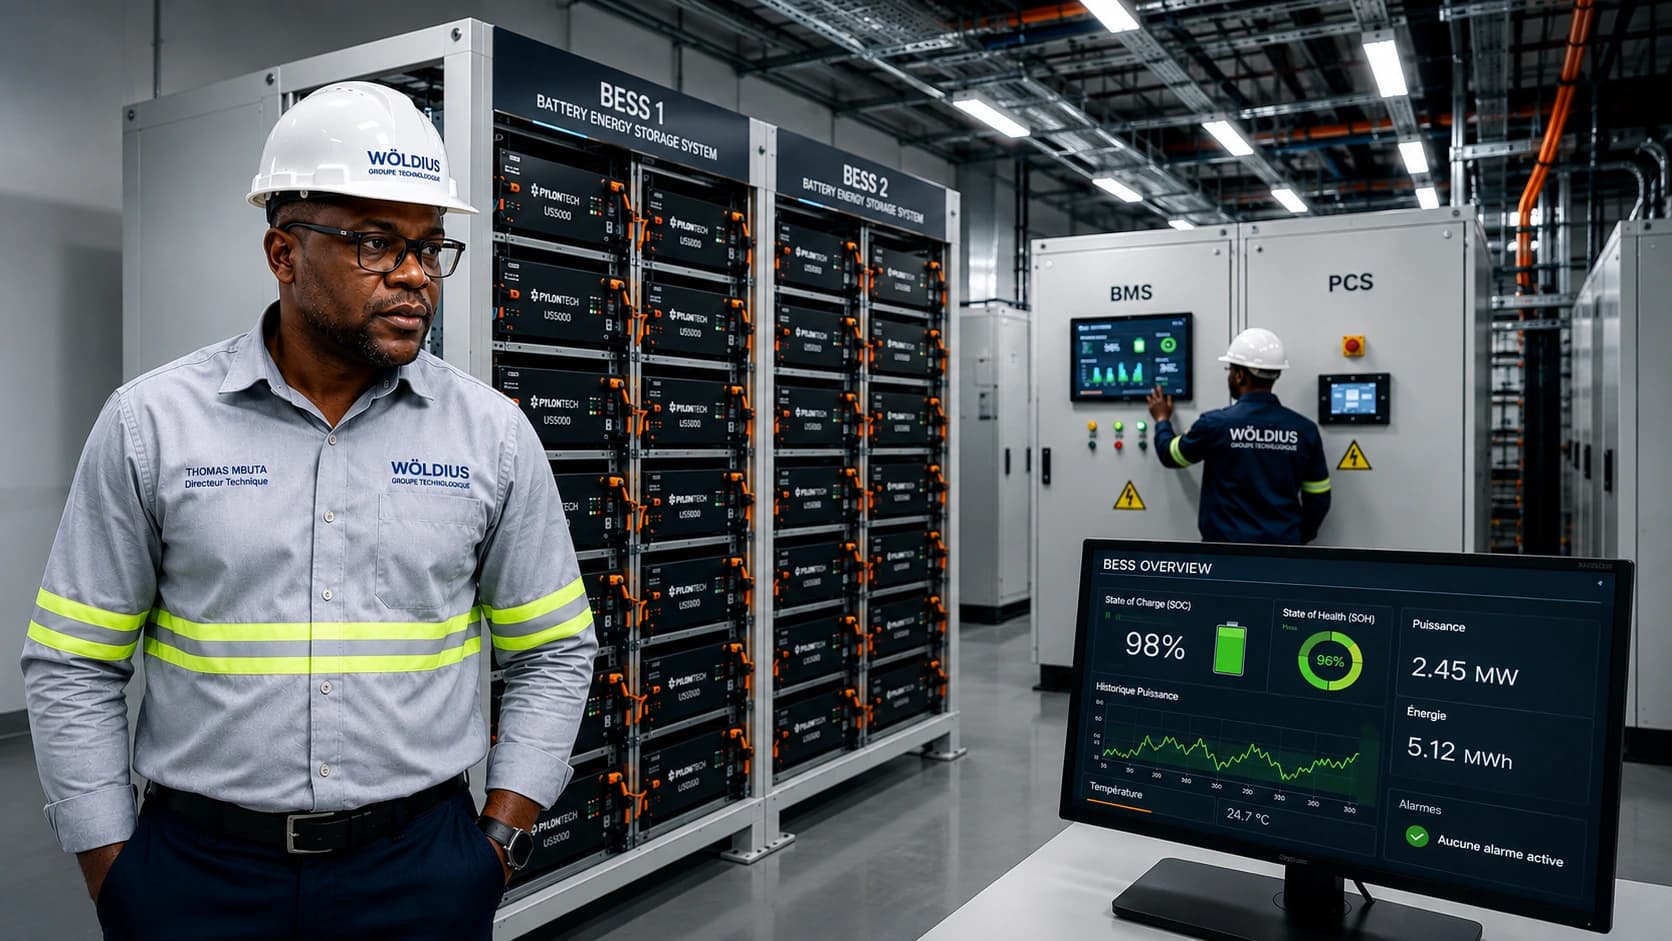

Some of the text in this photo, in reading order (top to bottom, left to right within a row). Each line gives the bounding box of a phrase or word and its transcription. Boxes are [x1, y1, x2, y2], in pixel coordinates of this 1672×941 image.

[600, 82, 664, 124] BESS 1
[537, 94, 717, 160] BATTERY ENERGY STORAGE SYSTEM
[367, 148, 440, 172] WÖLDIUS
[368, 168, 396, 176] GROUPE
[843, 164, 888, 198] BESS 2
[540, 188, 580, 206] PYLONTECH
[802, 178, 924, 224] BATTERY ENERGY STORAGE SYSTEM
[544, 206, 571, 220] US5000
[1329, 273, 1374, 292] PCS
[540, 292, 579, 306] PYLONTECH
[1110, 284, 1153, 301] BMS
[544, 310, 571, 322] US5000
[539, 398, 579, 409] PYLONTECH
[544, 416, 570, 425] US5000
[1230, 425, 1298, 444] WÖLDIUS
[185, 465, 267, 476] THOMAS MBUTA
[391, 459, 470, 479] WÖLDIUS
[185, 477, 268, 488] Directeur Technique
[1103, 558, 1212, 574] BESS OVERVIEW
[1105, 595, 1191, 611] State of Charge (SOC)
[1283, 608, 1375, 625] State of Health (SOH)
[1412, 619, 1466, 632] Puissance
[1126, 631, 1185, 660] 98%
[1316, 654, 1345, 668] 96%
[1412, 656, 1519, 686] 2.45 MW
[1096, 682, 1179, 700] Historique Puissance
[1407, 704, 1447, 722] Énergie
[1408, 736, 1512, 770] 5.12 MWh
[1090, 781, 1143, 799] Température
[1399, 799, 1442, 815] Alarmes
[1226, 807, 1270, 826] 24.7 °C
[1438, 834, 1564, 868] Aucune alarme active
